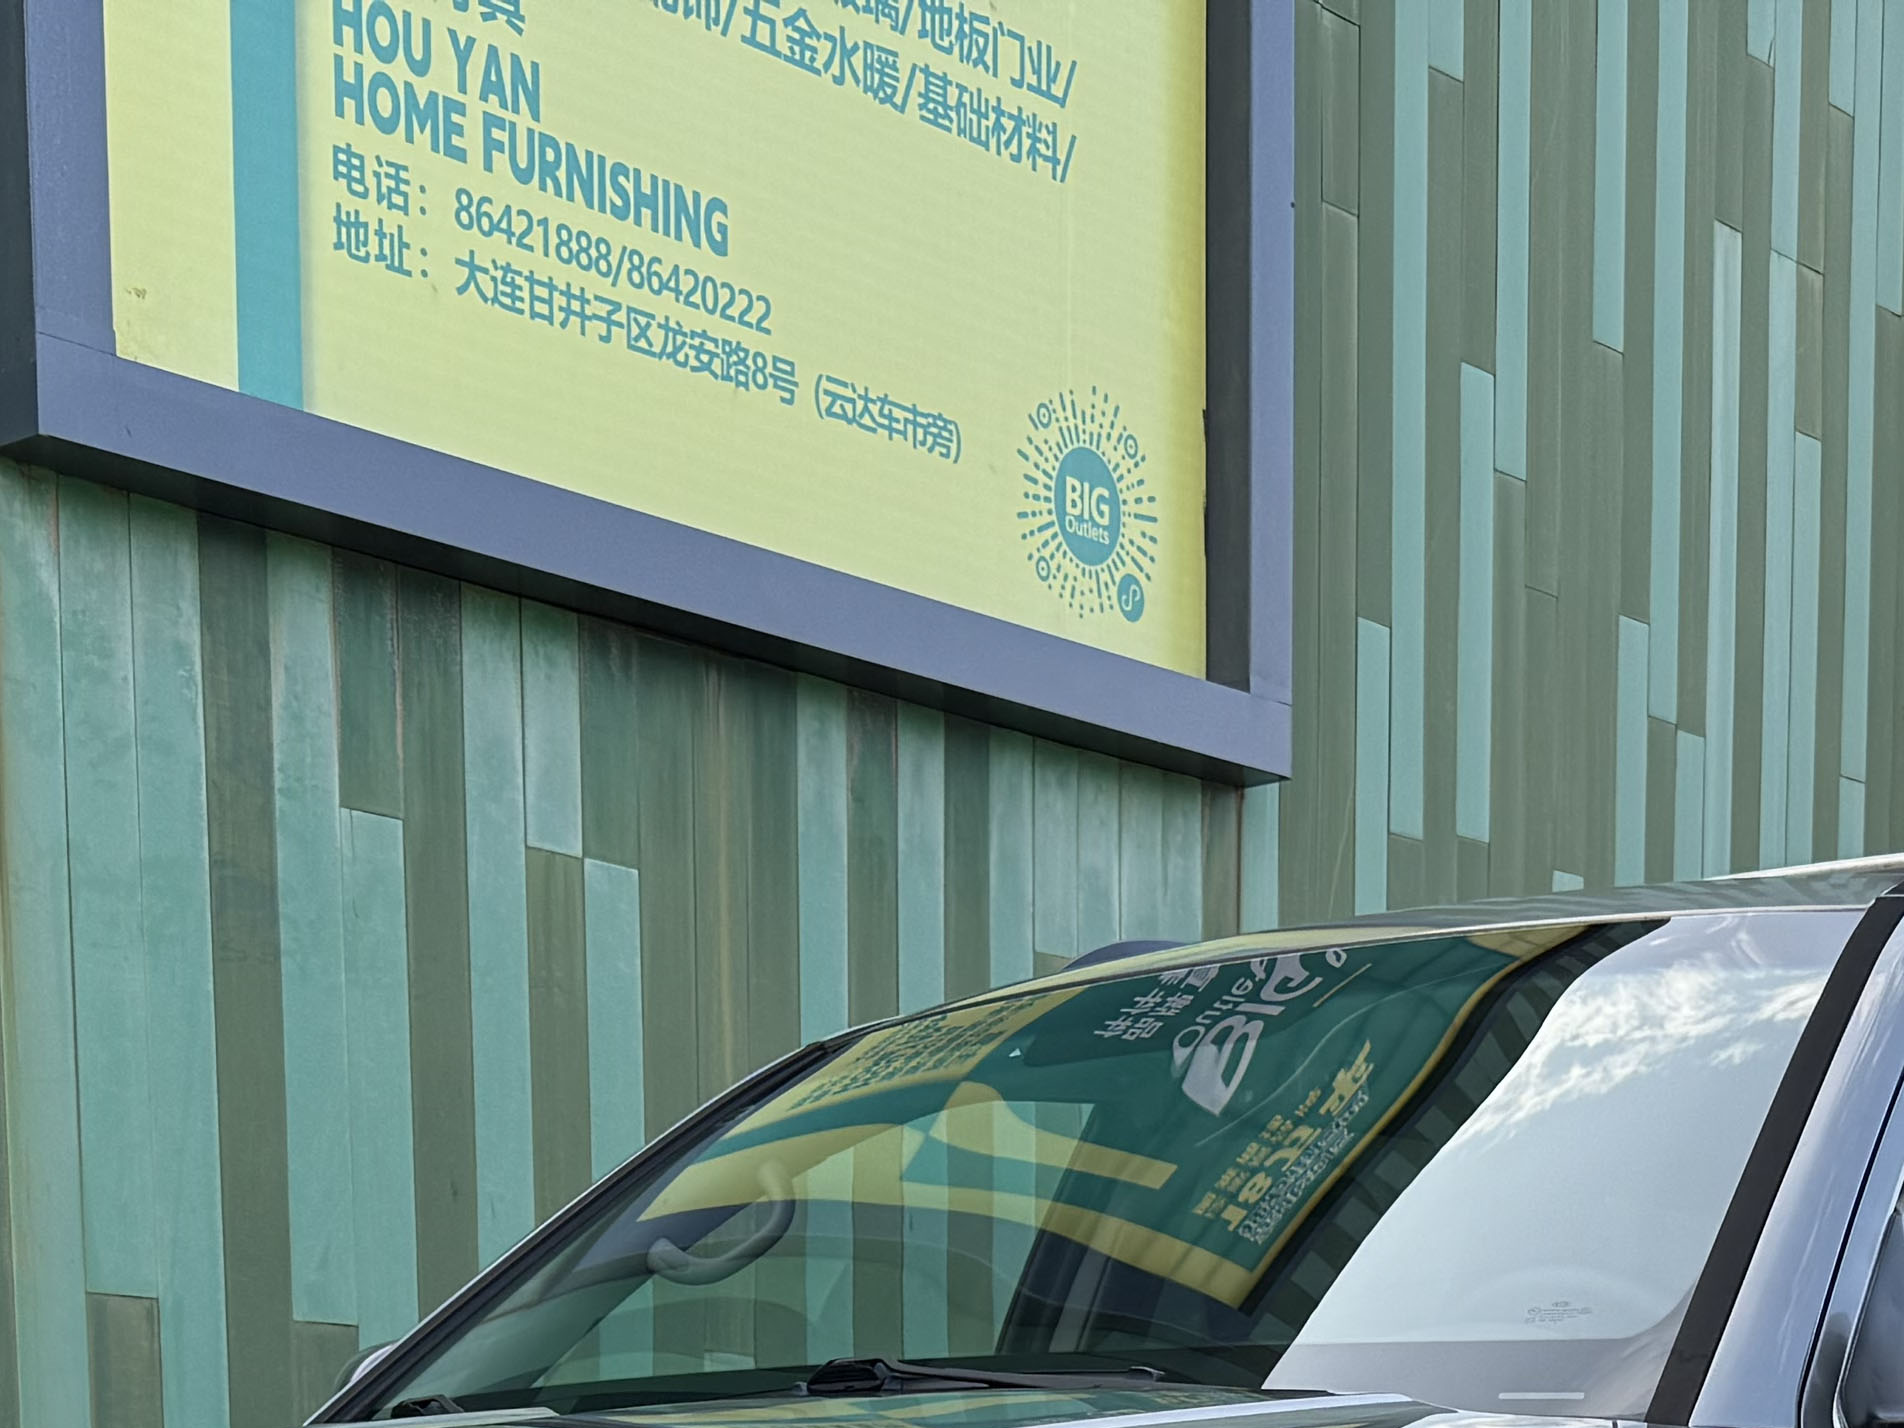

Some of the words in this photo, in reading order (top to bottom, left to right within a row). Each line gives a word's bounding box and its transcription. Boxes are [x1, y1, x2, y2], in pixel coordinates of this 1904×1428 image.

[332, 0, 432, 77] HOU
[447, 27, 540, 123] YAN
[333, 53, 467, 164] HOME
[482, 110, 729, 257] FURNISHING
[1065, 475, 1110, 527] BIG
[1065, 516, 1110, 546] Outlets
